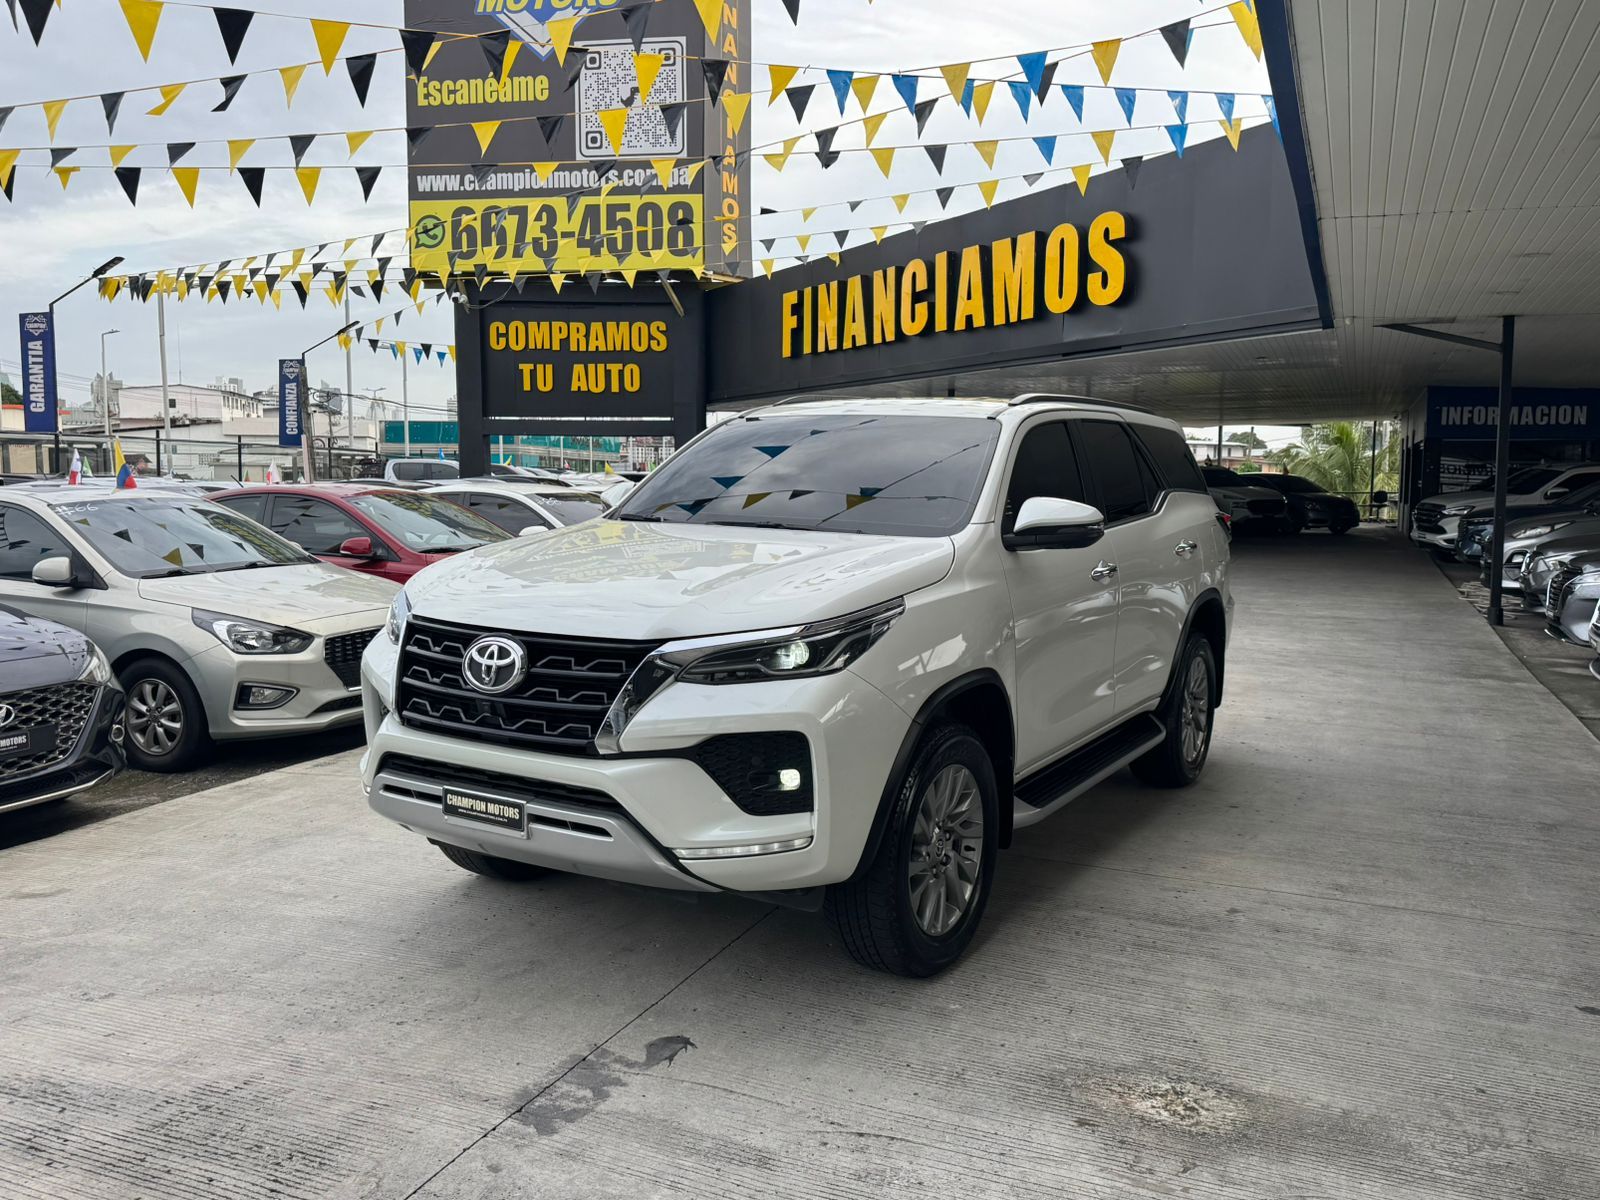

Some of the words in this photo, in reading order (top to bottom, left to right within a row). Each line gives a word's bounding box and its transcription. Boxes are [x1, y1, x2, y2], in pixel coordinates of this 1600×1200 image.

[417, 71, 549, 107] Escanéame
[451, 201, 694, 261] 6673-4508
[781, 210, 1127, 359] FINANCIAMOS
[489, 320, 668, 352] COMPRAMOS
[28, 340, 46, 413] GARANTIA
[518, 363, 554, 392] TU
[570, 363, 641, 393] AUTO
[285, 382, 298, 435] CONFIANZA
[446, 793, 487, 813] CHAMPION
[487, 802, 520, 820] MOTORS
